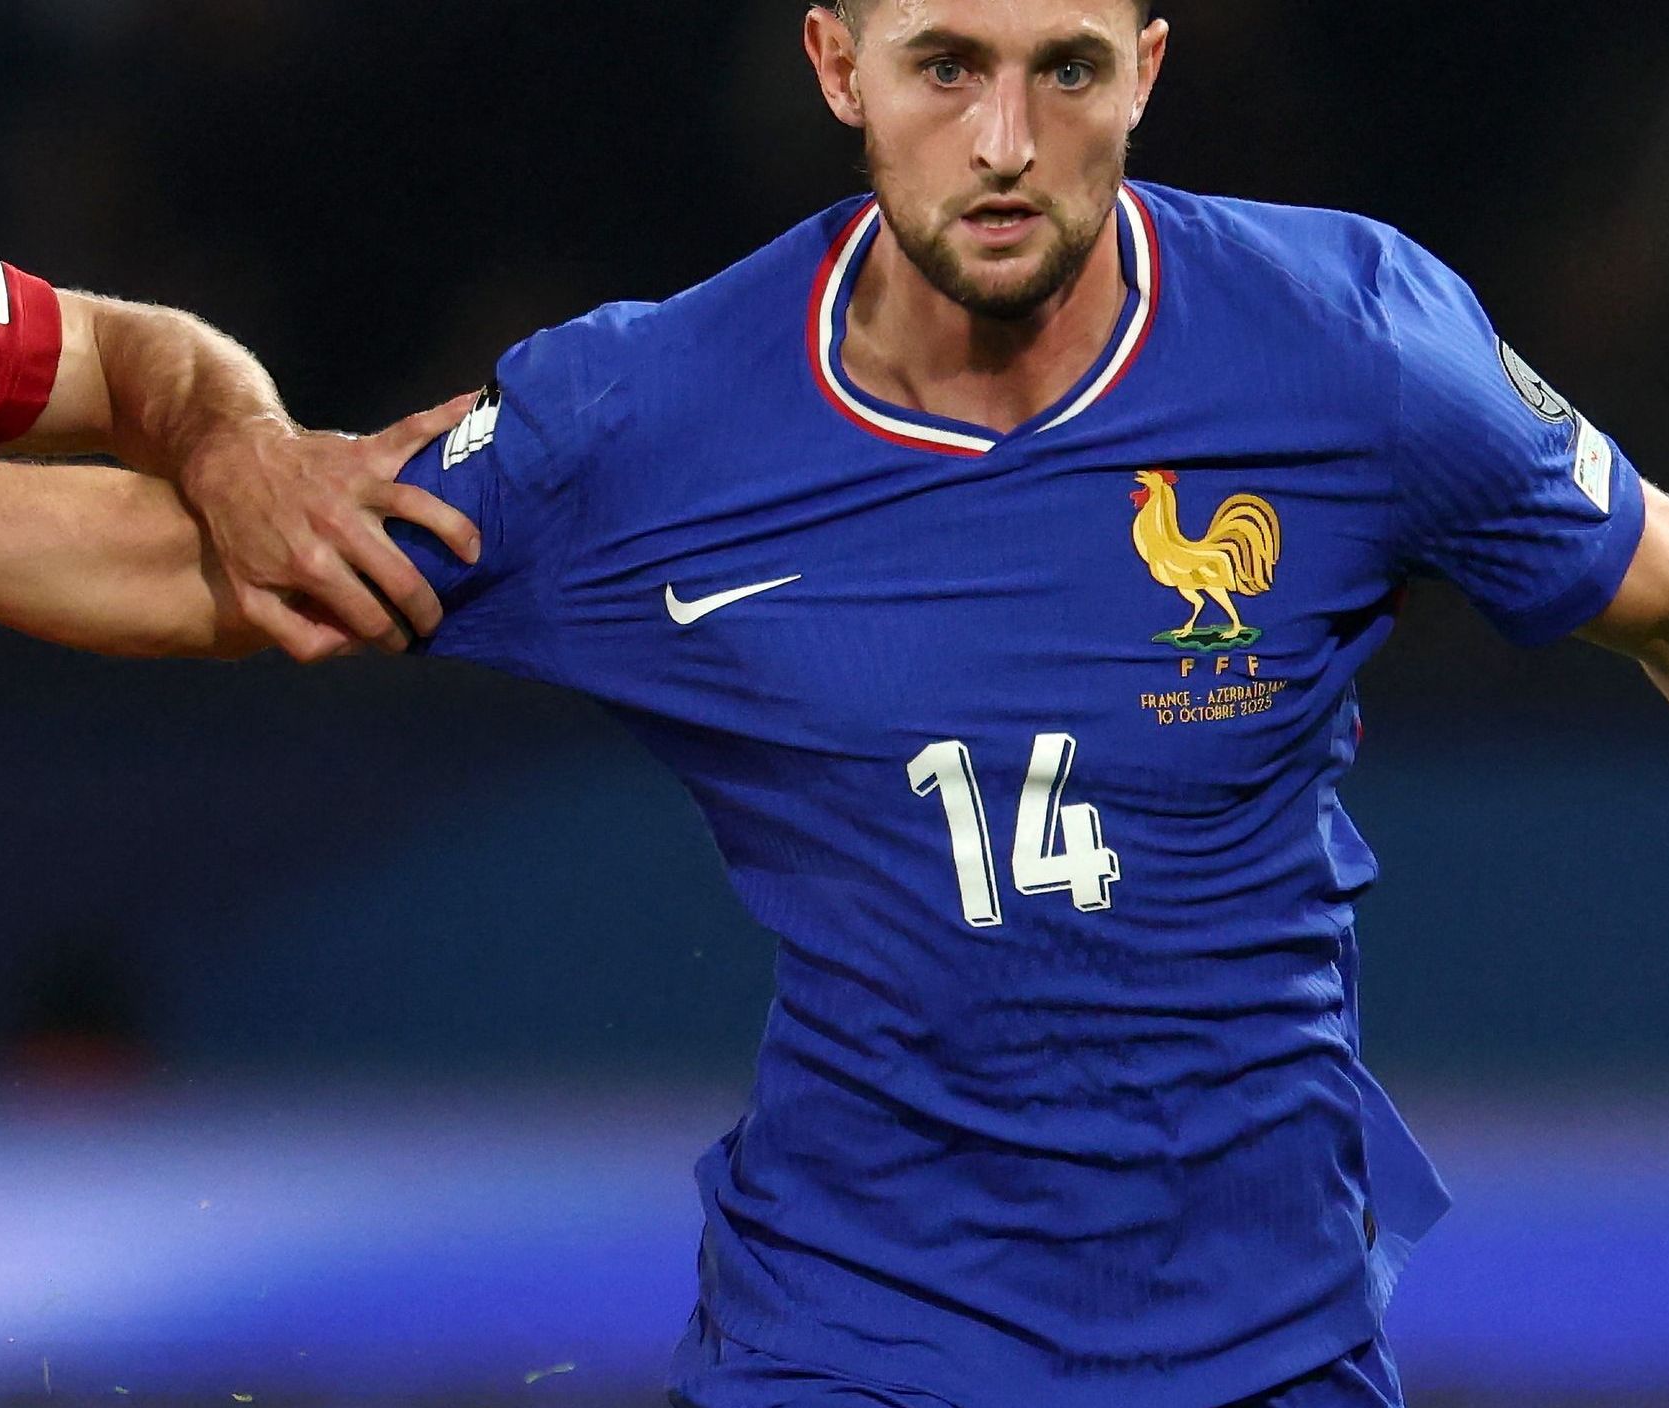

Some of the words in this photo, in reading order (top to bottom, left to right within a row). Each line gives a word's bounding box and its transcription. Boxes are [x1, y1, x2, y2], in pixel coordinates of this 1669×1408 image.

[1140, 691, 1191, 709] FRANCE
[1156, 709, 1174, 725] 10
[1179, 704, 1236, 722] OCTOBRE
[1240, 698, 1272, 716] 2025
[906, 732, 1121, 928] 14
